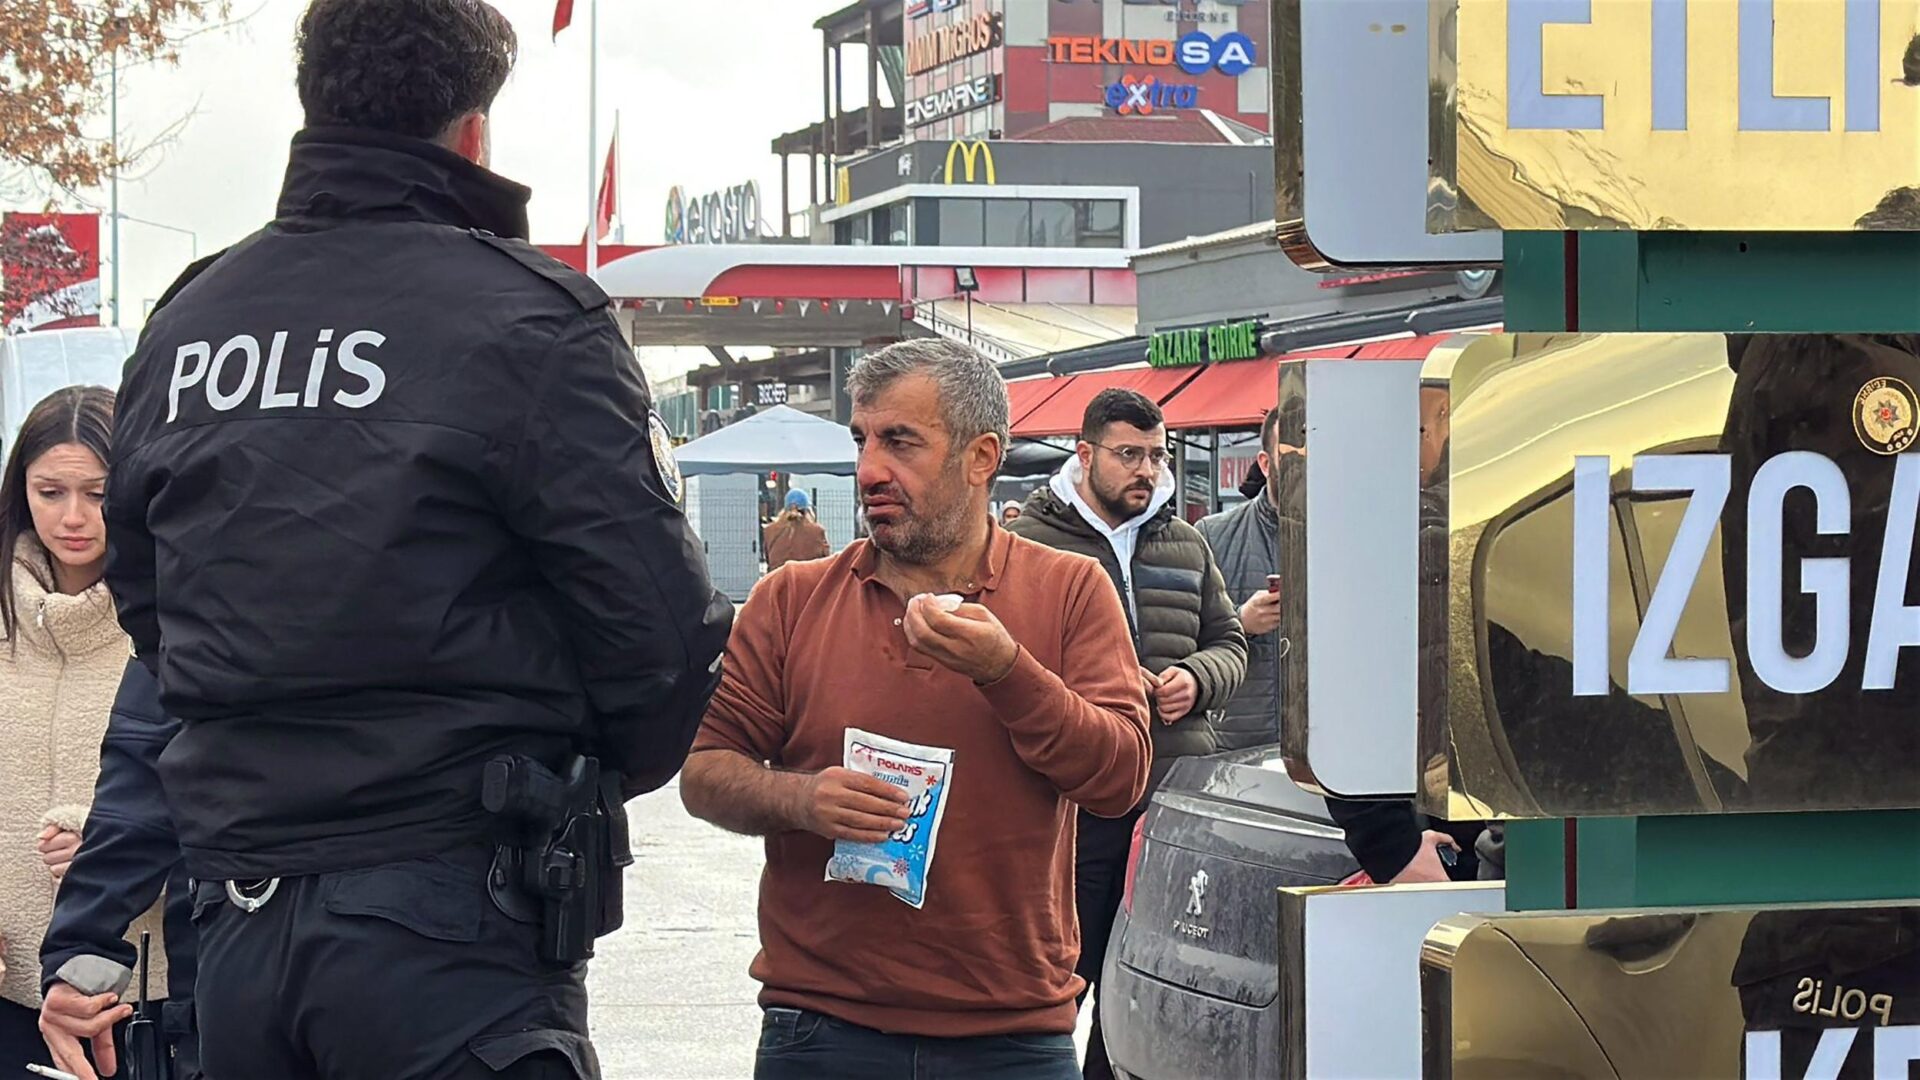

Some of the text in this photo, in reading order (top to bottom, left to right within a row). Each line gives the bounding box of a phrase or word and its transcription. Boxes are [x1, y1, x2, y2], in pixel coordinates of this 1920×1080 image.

[1048, 32, 1256, 75] TEKNOSA
[1106, 74, 1198, 115] extra
[1149, 328, 1203, 369] BAZAAR
[877, 757, 923, 777] POLARIS
[1173, 920, 1209, 938] PUGEOT
